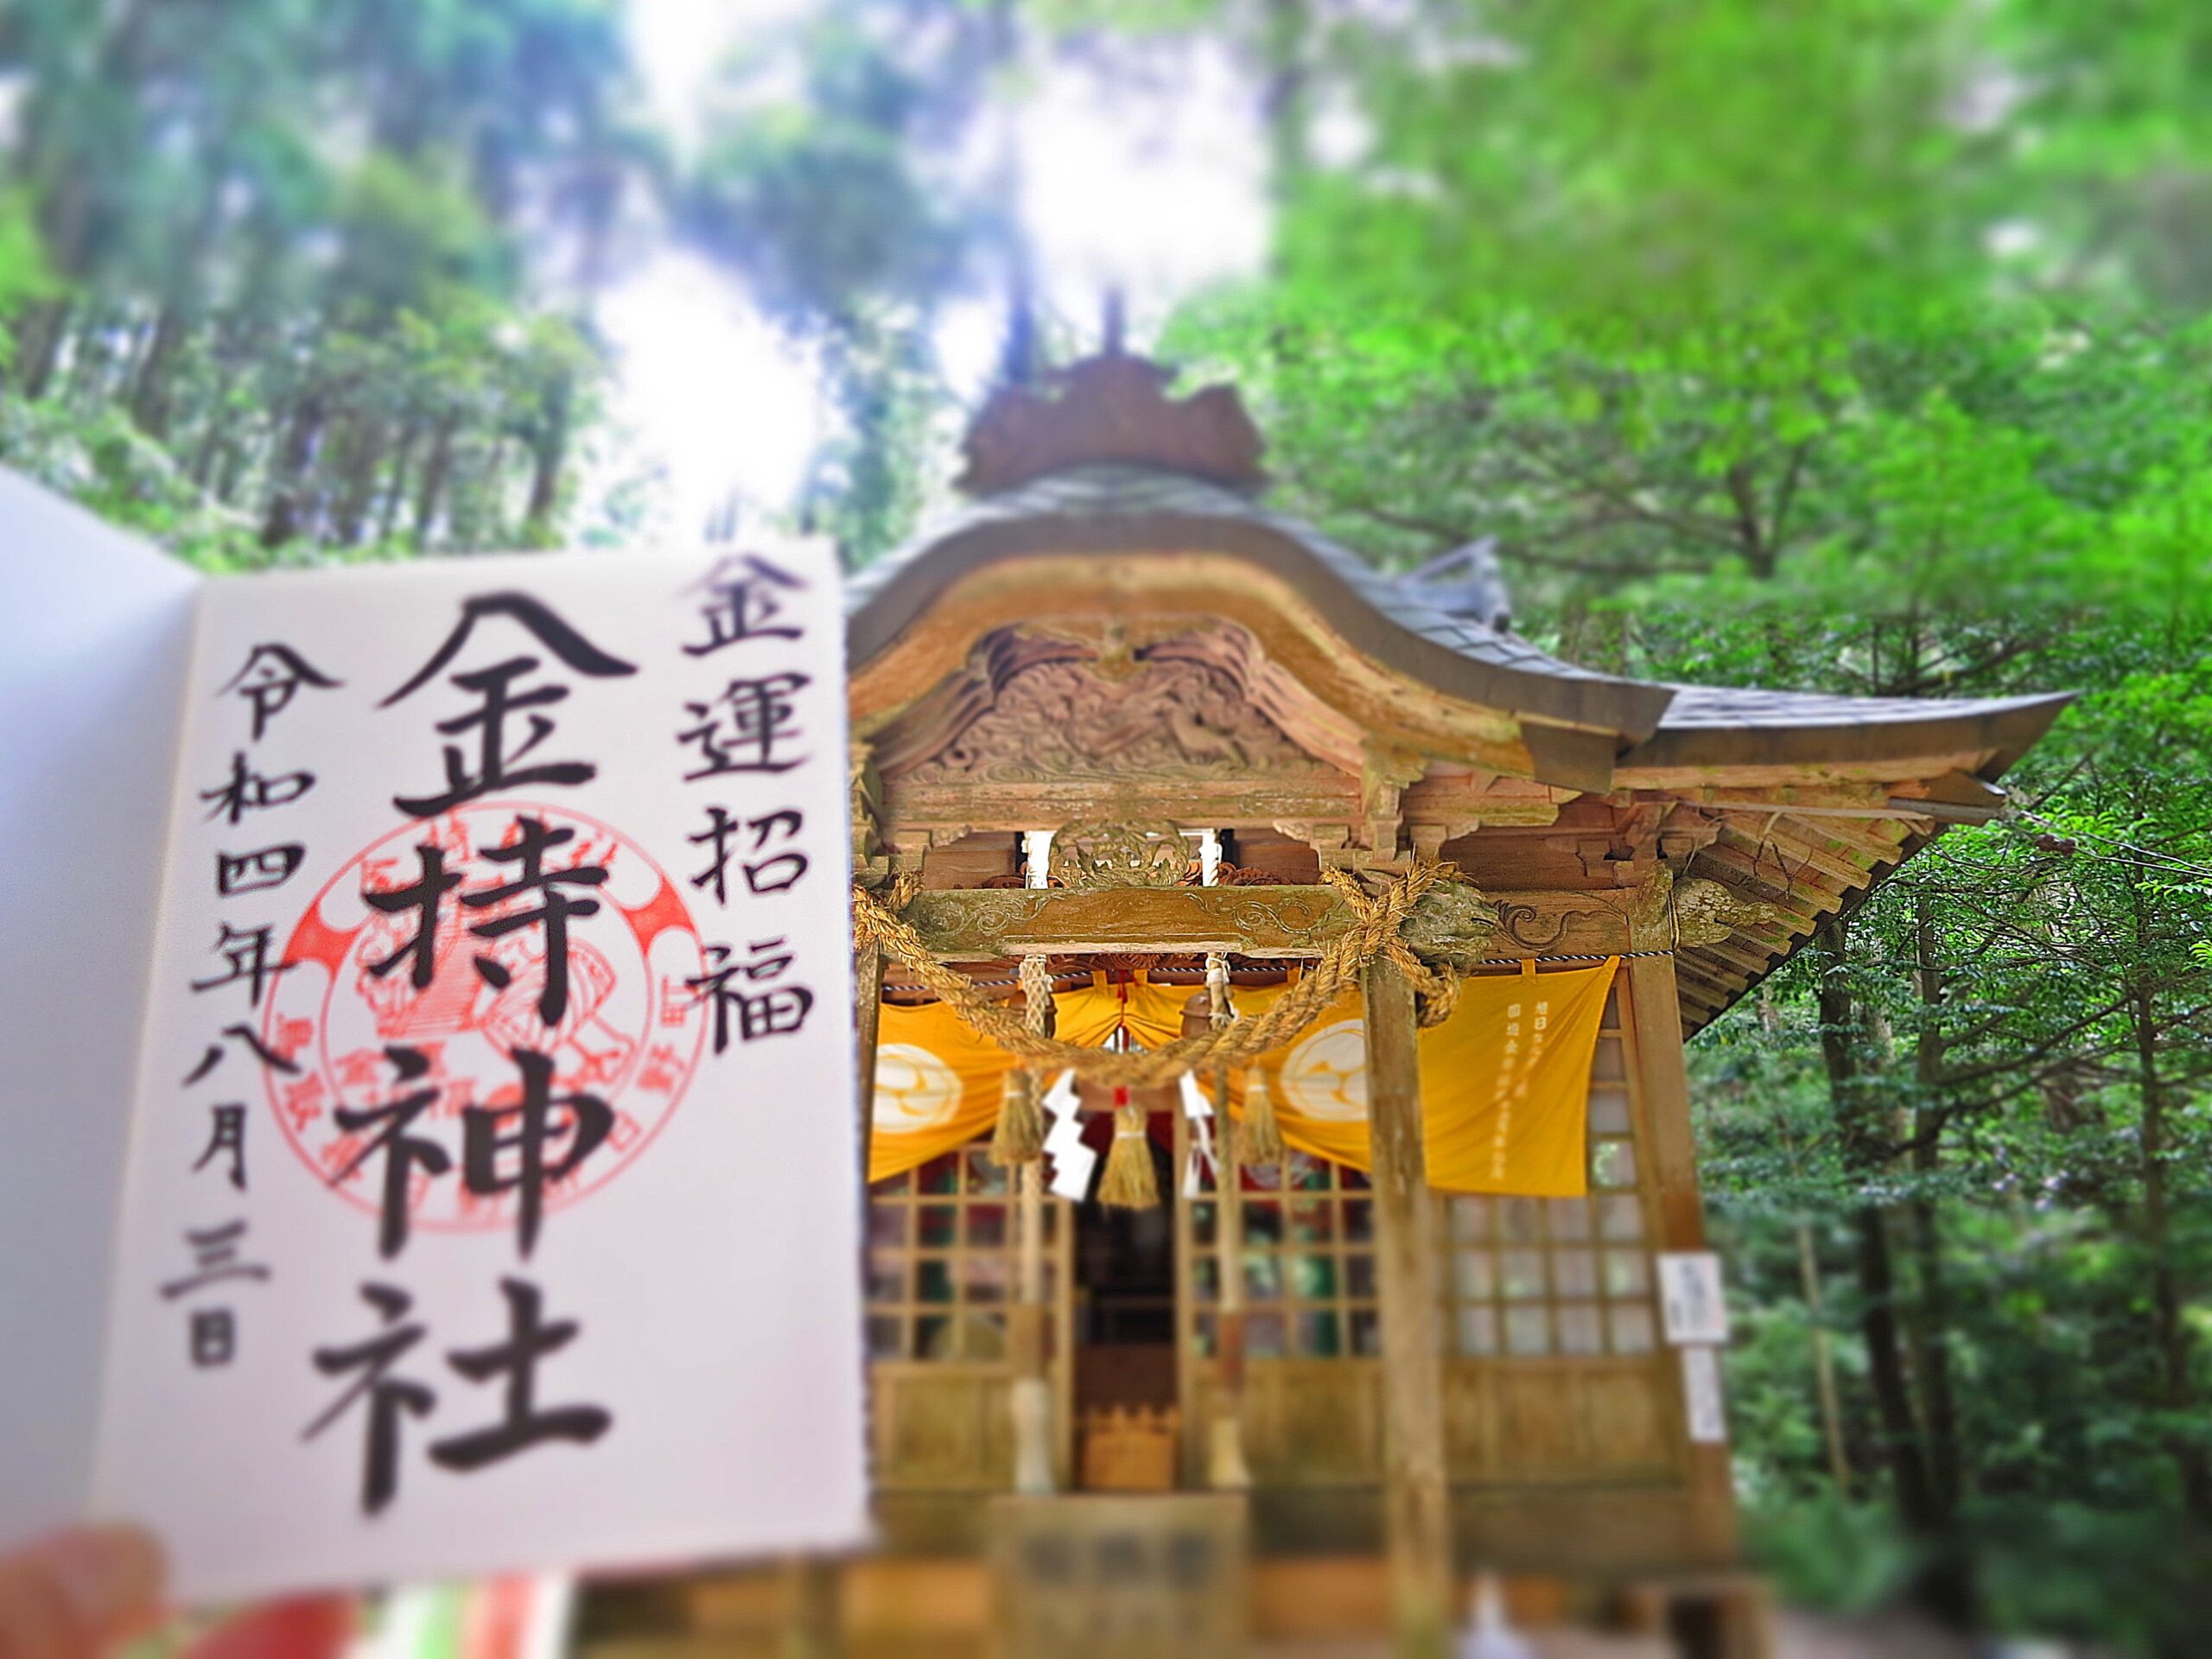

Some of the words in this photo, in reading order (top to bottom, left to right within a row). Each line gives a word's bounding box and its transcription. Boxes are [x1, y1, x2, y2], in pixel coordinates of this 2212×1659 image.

[159, 642, 346, 1369] 令和四年八月三日
[300, 592, 638, 1519] 金持神社
[677, 554, 812, 1056] 金運招福
